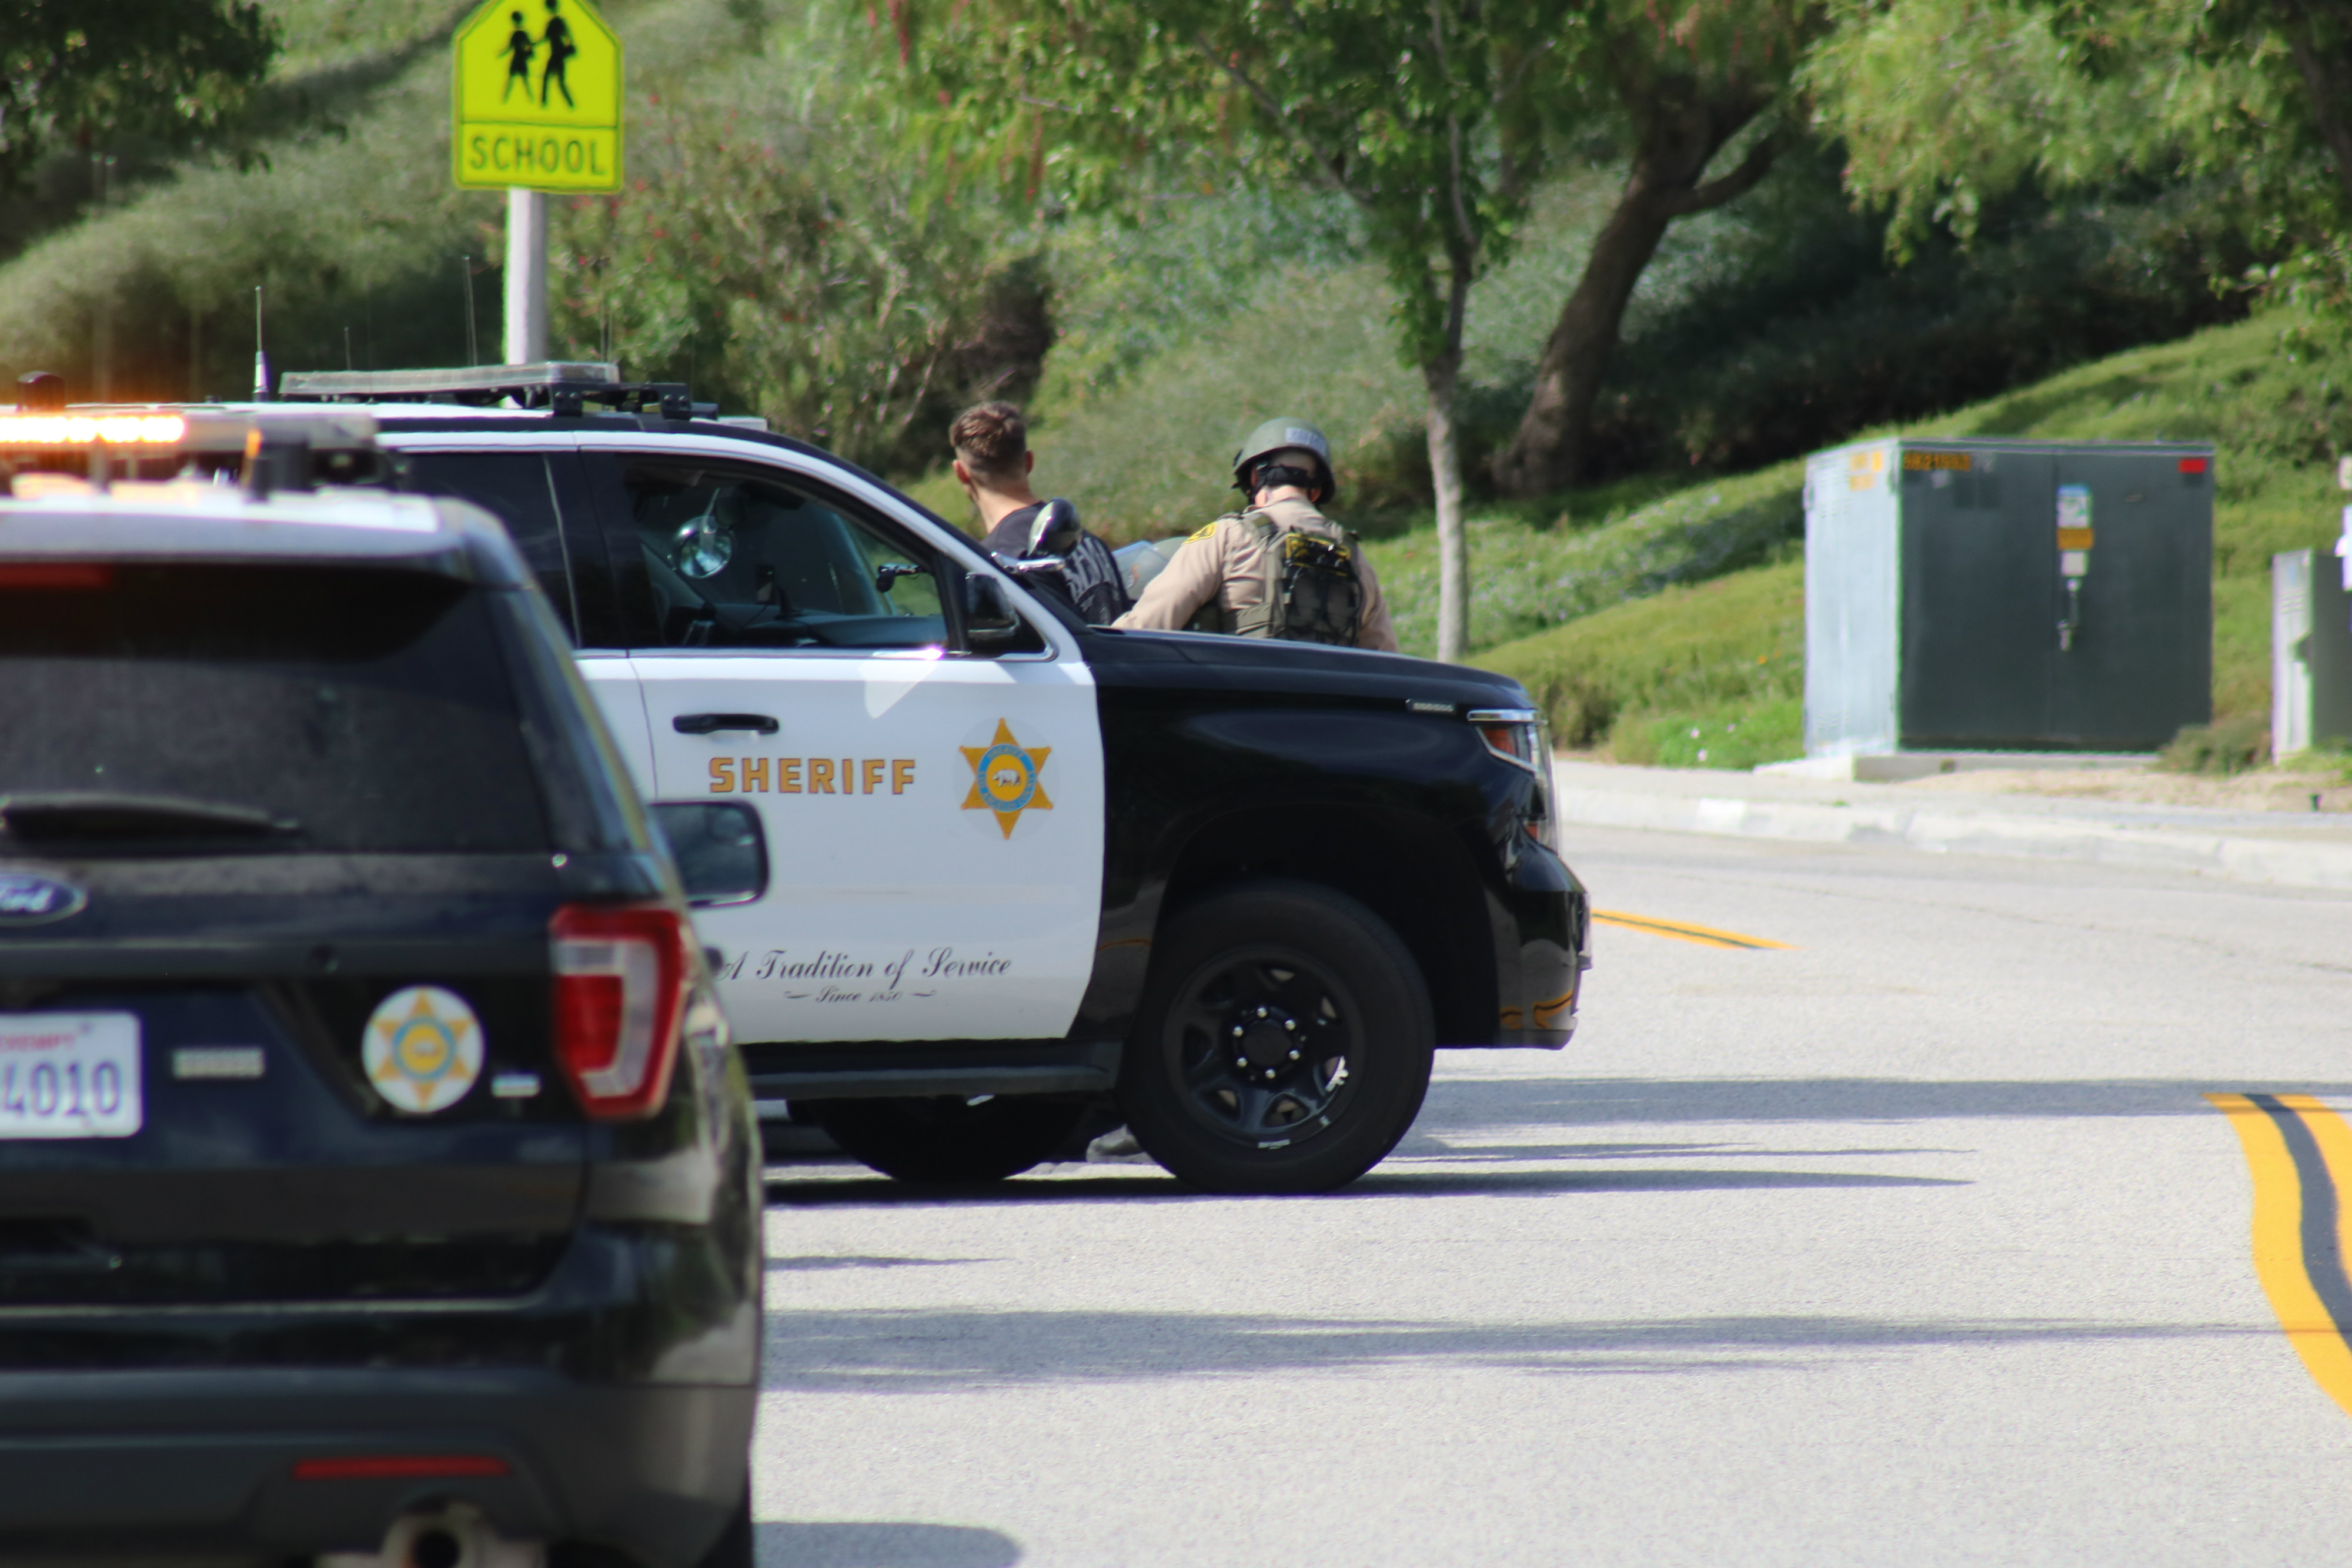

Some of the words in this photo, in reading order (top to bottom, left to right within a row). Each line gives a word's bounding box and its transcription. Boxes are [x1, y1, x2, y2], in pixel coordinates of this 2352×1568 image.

[470, 136, 606, 175] SCHOOL
[709, 757, 916, 794] SHERIFF
[756, 950, 874, 979] Tradition
[884, 948, 914, 991] of
[923, 947, 1012, 977] Service
[816, 985, 862, 1002] Since
